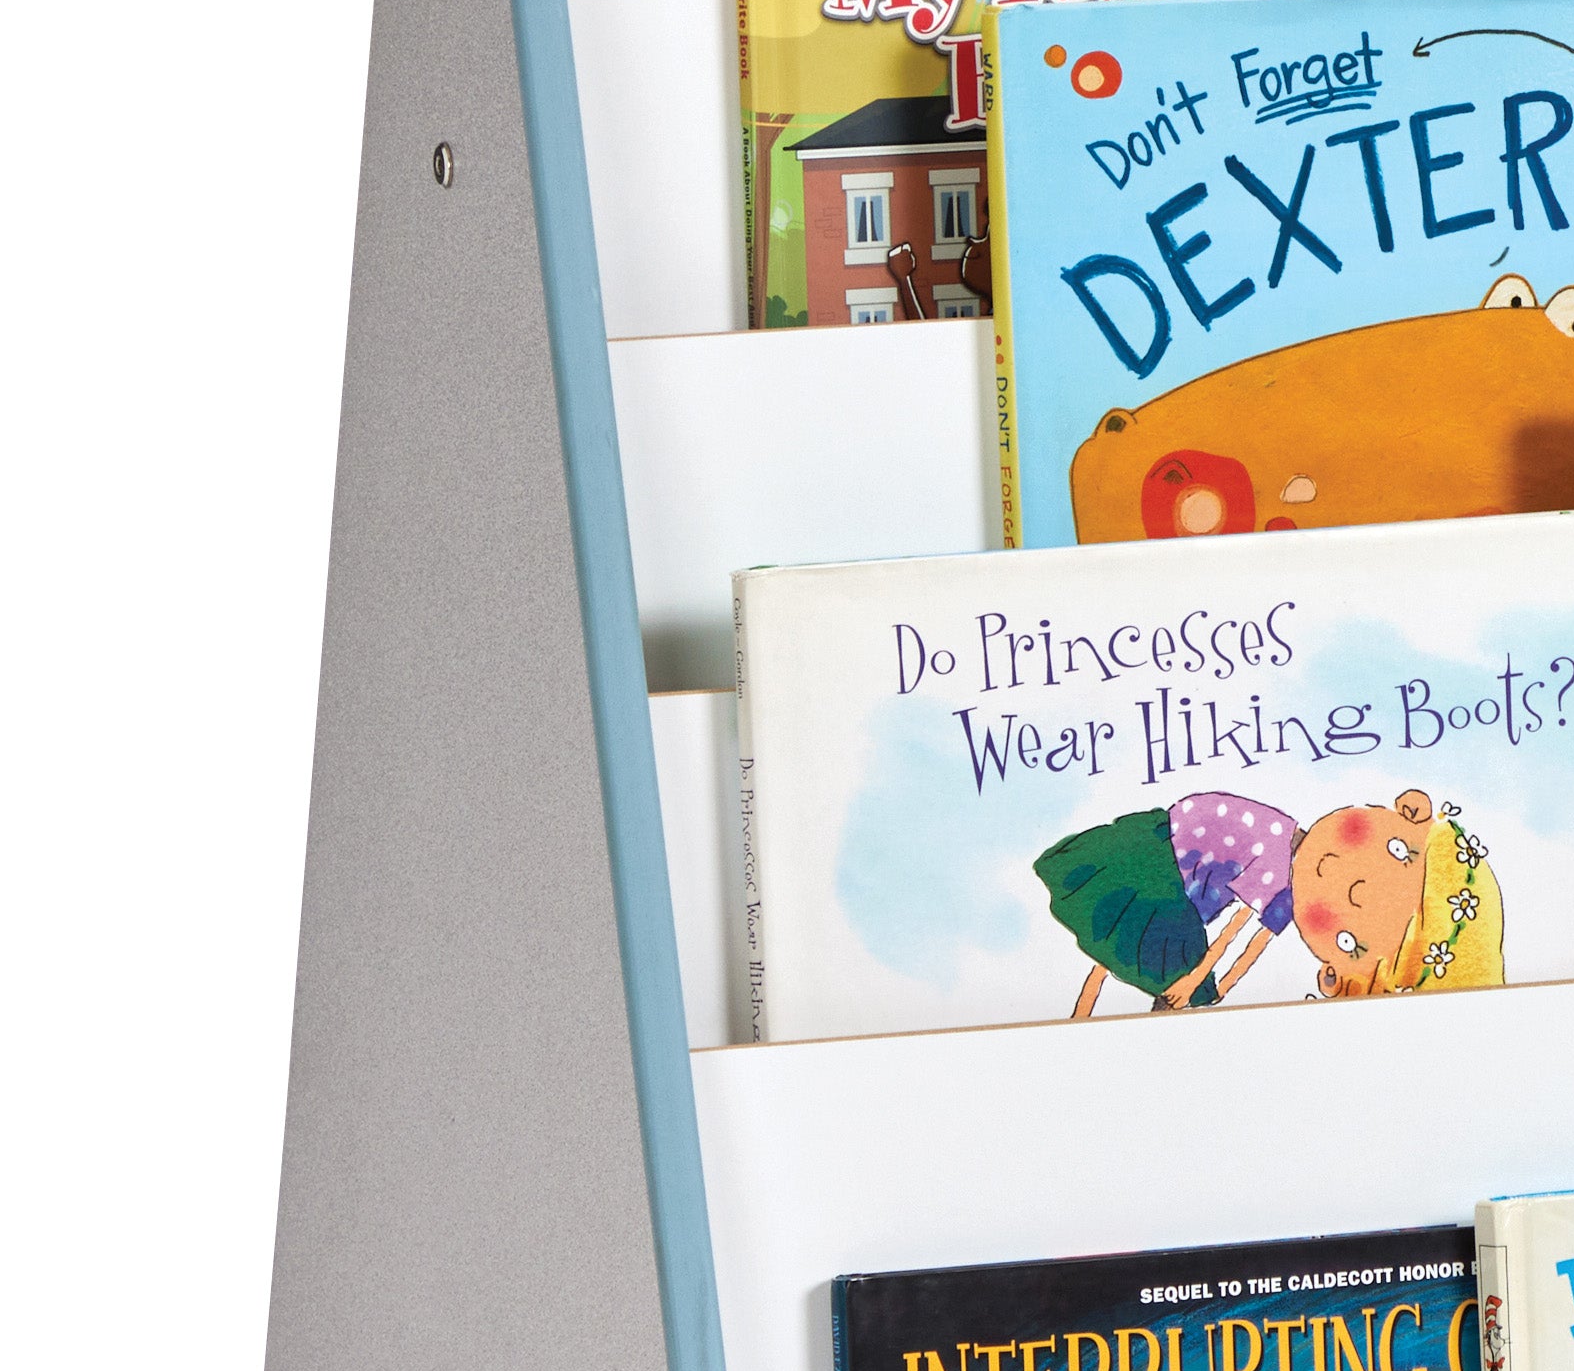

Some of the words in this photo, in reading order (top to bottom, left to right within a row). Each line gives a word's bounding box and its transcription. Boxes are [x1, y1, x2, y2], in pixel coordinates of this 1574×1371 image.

[739, 34, 750, 80] Book
[983, 53, 994, 112] WARD
[1086, 81, 1209, 190] Don't
[1232, 31, 1384, 111] Forget
[996, 377, 1010, 453] DON'T
[893, 624, 956, 696] Do
[975, 600, 1297, 693] Princesses
[953, 706, 1115, 797] Wear
[1136, 687, 1382, 785] Hiking
[1140, 1283, 1213, 1305] SEQUEL
[1218, 1280, 1243, 1298] TO
[1247, 1276, 1283, 1295] THE
[1287, 1267, 1394, 1292] CALDECOTT
[1399, 1261, 1466, 1281] HONOR
